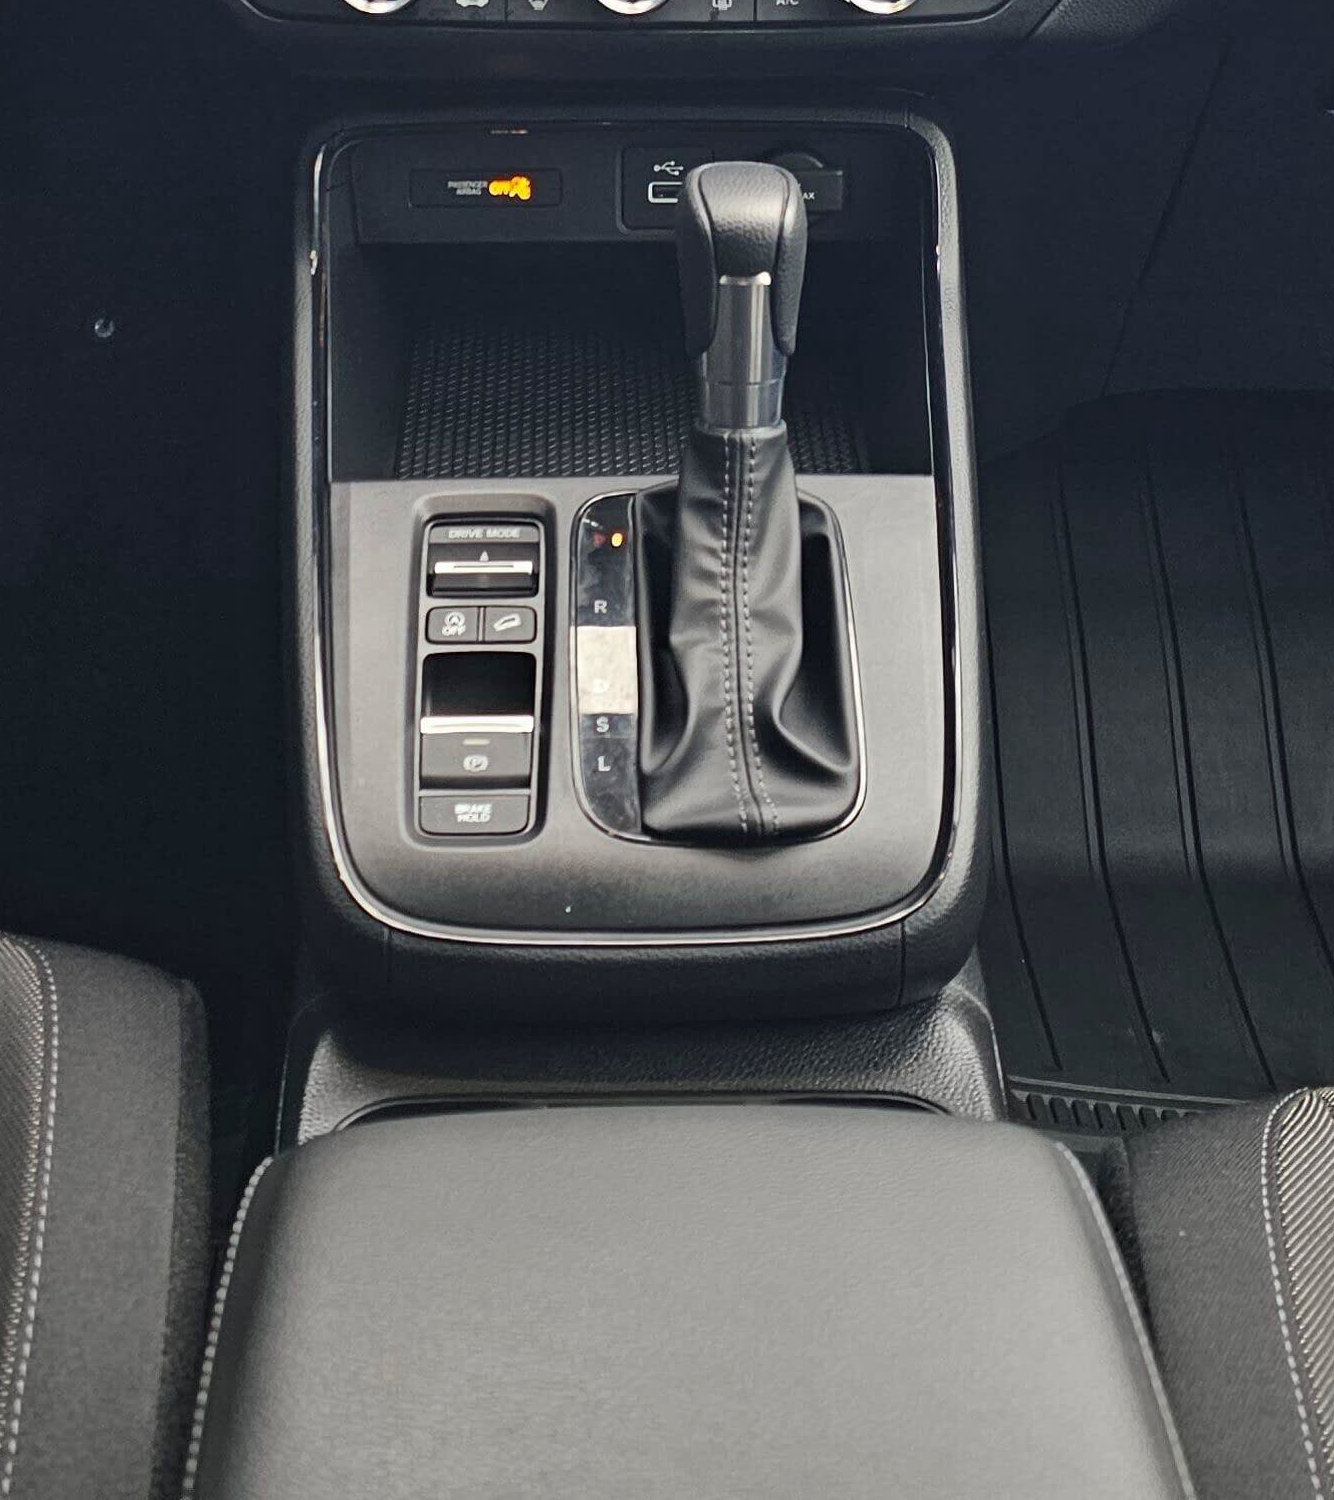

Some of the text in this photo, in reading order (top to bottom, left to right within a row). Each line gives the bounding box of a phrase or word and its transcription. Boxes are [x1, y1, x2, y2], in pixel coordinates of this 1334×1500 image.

[802, 191, 815, 200] AX
[448, 528, 521, 539] DRIVE MODE
[594, 600, 607, 614] R
[442, 625, 467, 636] OFF
[596, 716, 610, 732] S
[597, 755, 611, 771] L
[454, 803, 493, 814] BRAKE
[456, 812, 492, 824] HOLD
